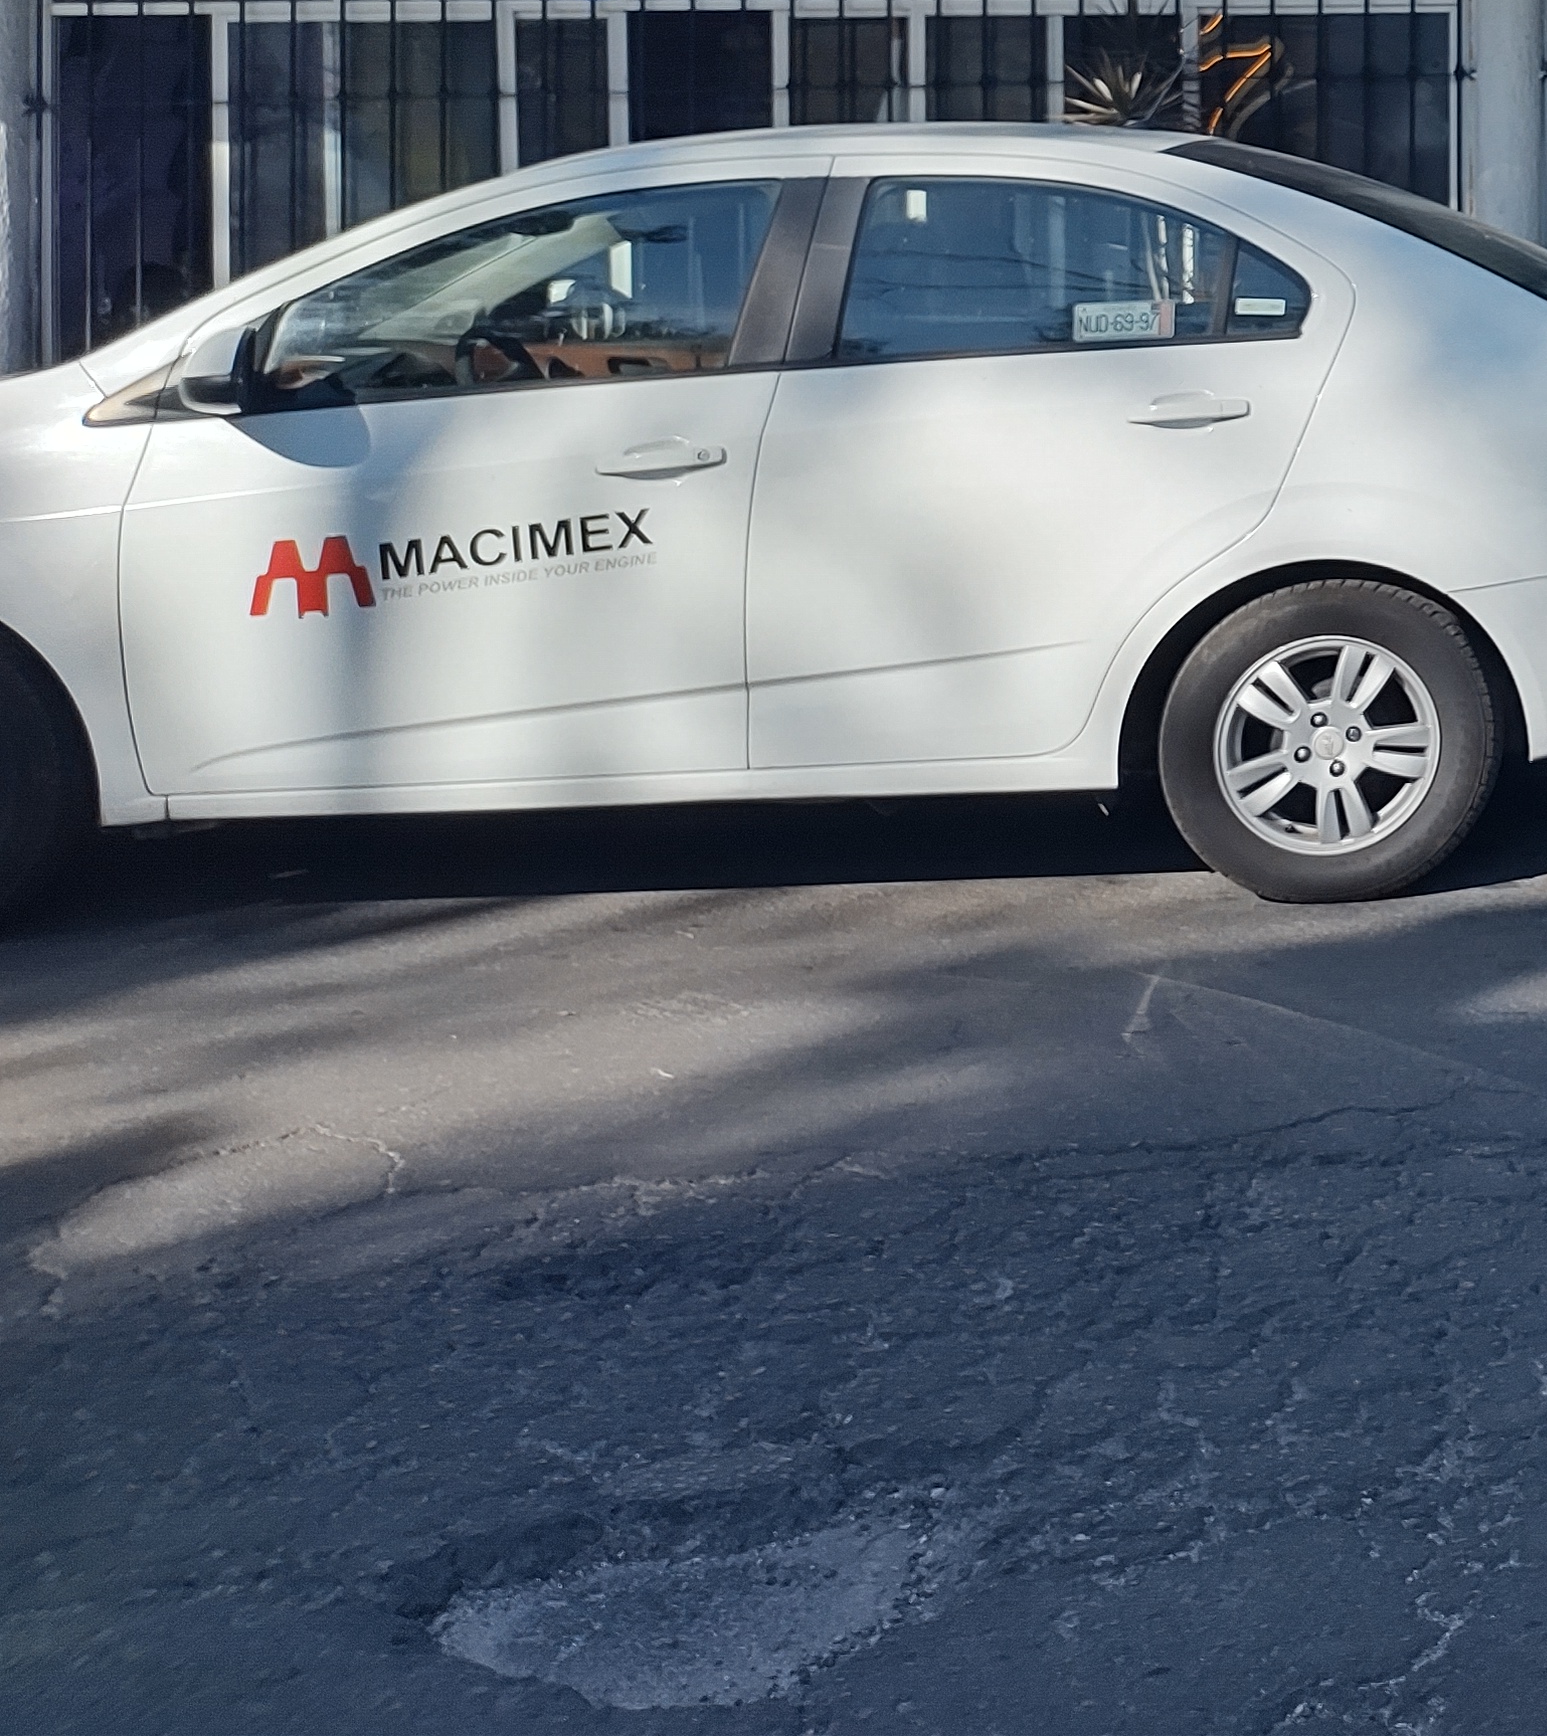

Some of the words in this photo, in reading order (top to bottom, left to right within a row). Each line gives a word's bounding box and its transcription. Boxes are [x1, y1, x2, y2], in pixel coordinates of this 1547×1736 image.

[379, 508, 653, 580] MACIMEX
[382, 584, 413, 601] THE
[419, 575, 479, 595] POWER
[484, 567, 538, 585] INSIDE
[544, 561, 590, 578] YOUR
[595, 551, 658, 571] ENGINE
